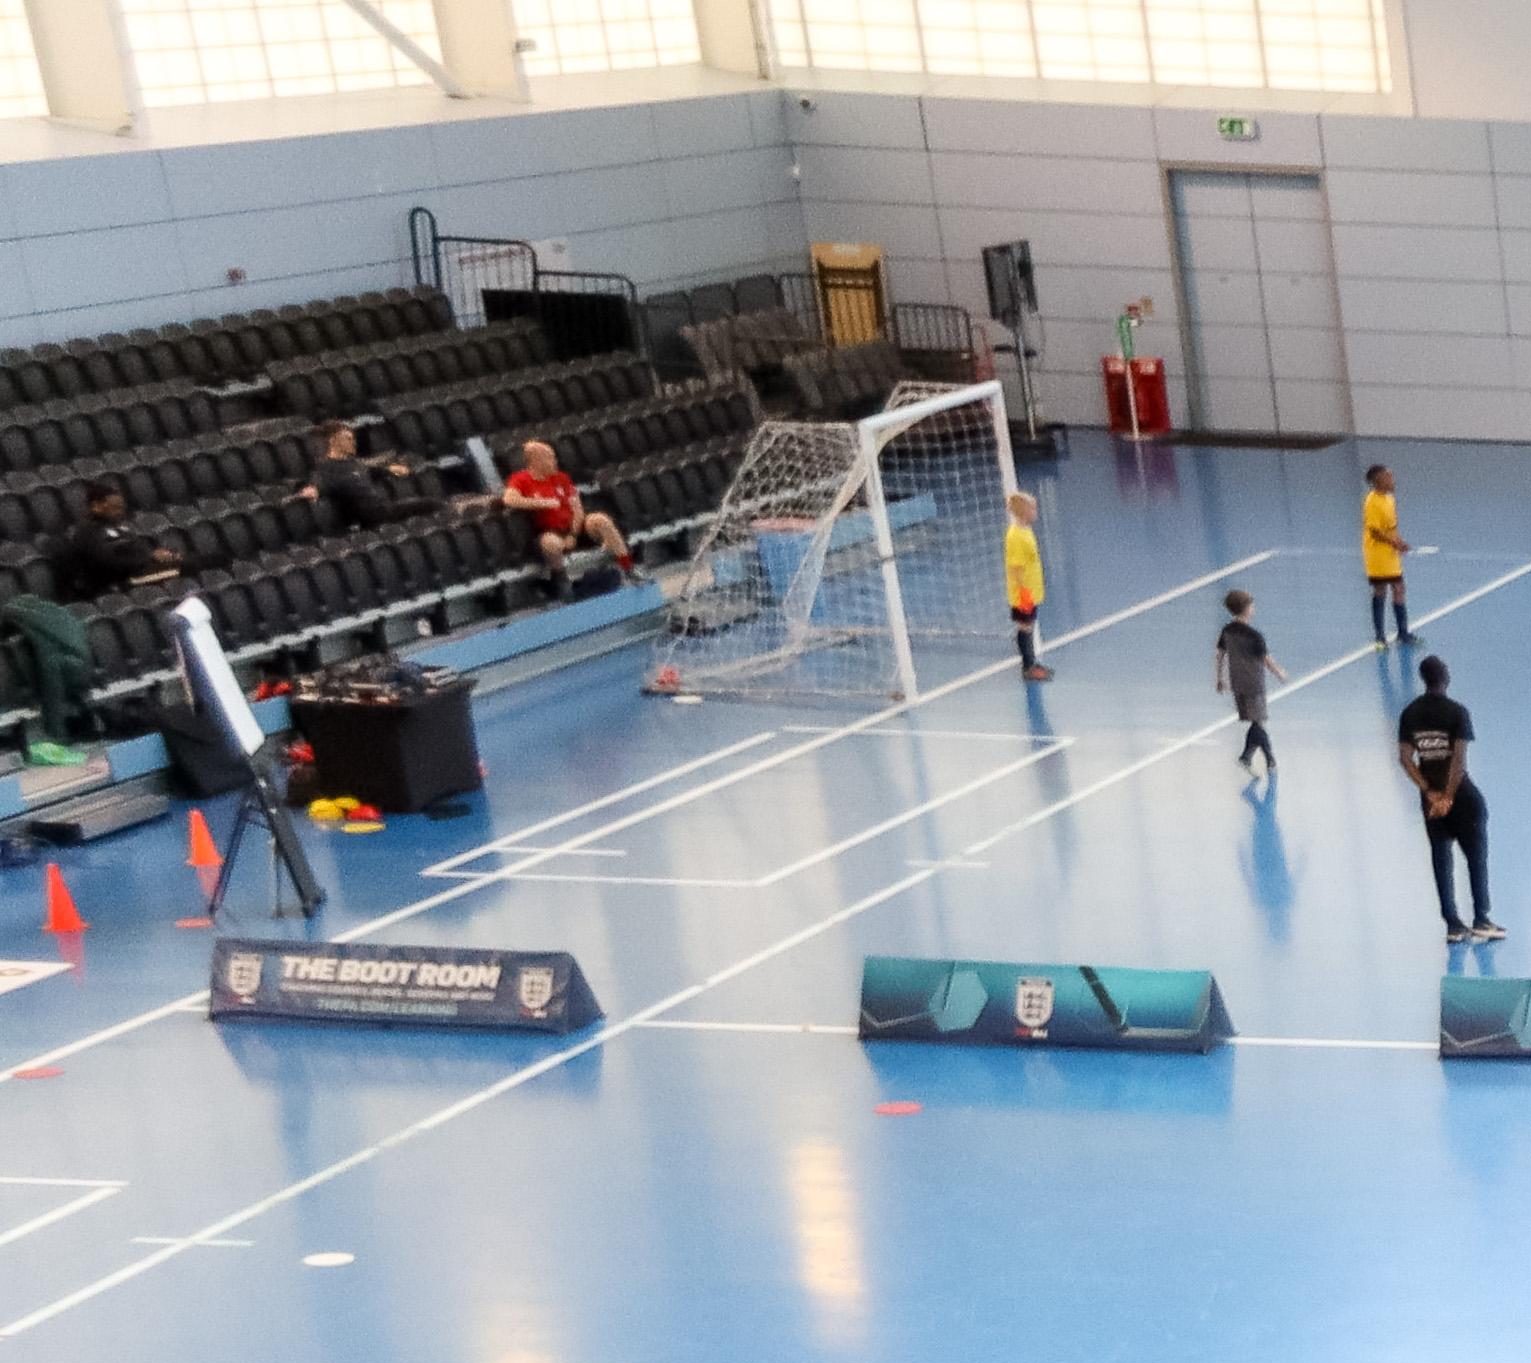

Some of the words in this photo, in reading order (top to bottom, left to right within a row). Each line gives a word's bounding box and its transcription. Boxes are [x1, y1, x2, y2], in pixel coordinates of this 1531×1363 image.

[282, 955, 337, 980] THE
[338, 959, 417, 984] BOOT
[416, 962, 501, 989] ROOM
